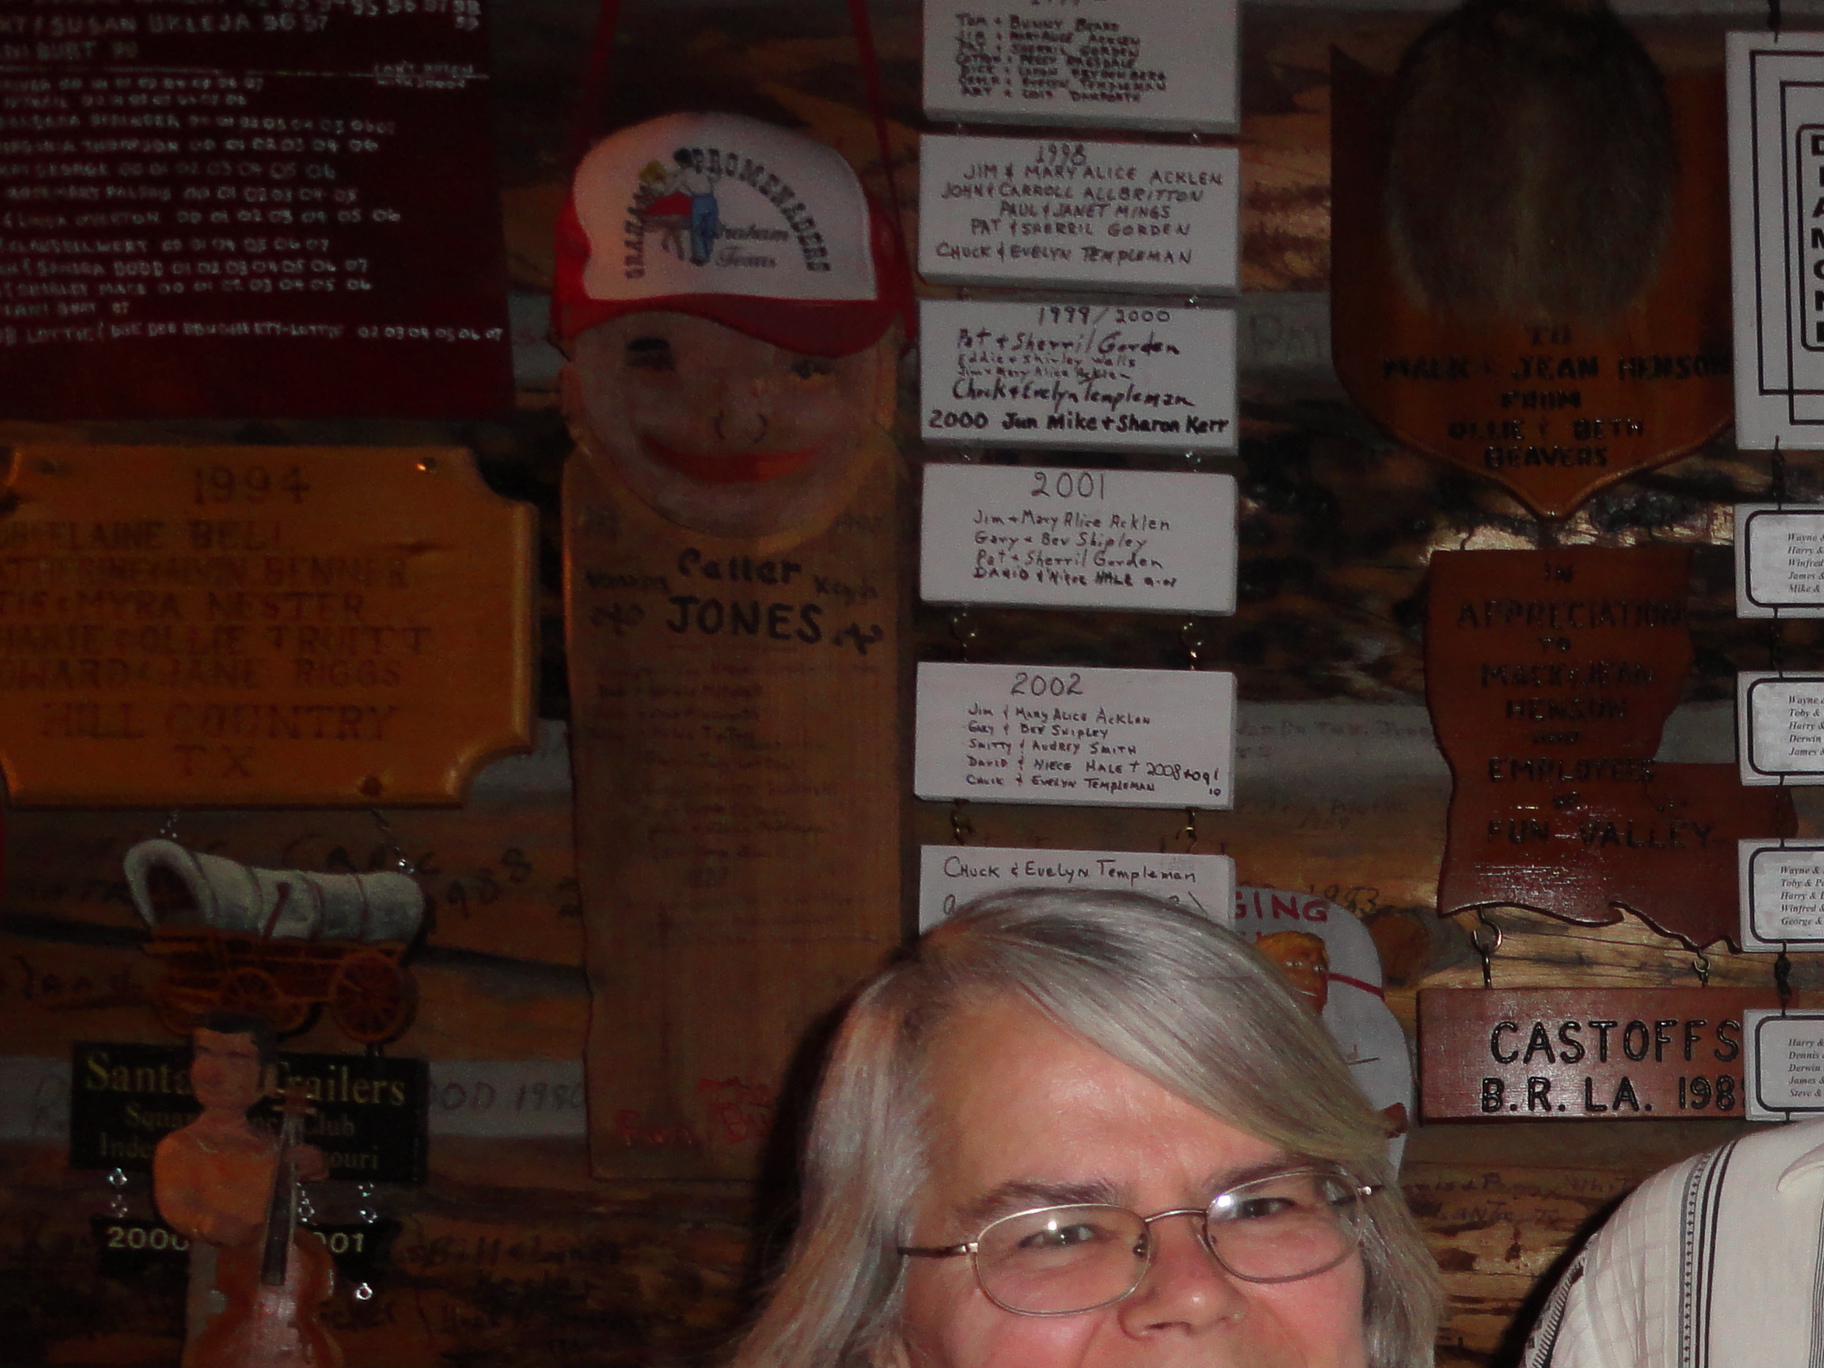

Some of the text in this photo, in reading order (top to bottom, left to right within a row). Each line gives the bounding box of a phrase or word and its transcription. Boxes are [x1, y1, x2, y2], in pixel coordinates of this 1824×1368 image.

[963, 164, 997, 180] JIM
[1024, 164, 1075, 180] MARY
[1083, 165, 1136, 181] ALICE
[930, 410, 989, 428] 2000
[194, 465, 311, 507] 1994
[1032, 471, 1105, 500] 2001
[665, 595, 822, 645] JONES
[1011, 672, 1084, 696] 2002
[165, 703, 401, 741] COUNTRY
[1490, 1020, 1741, 1064] CASTOFFS
[1678, 1074, 1745, 1112] 198
